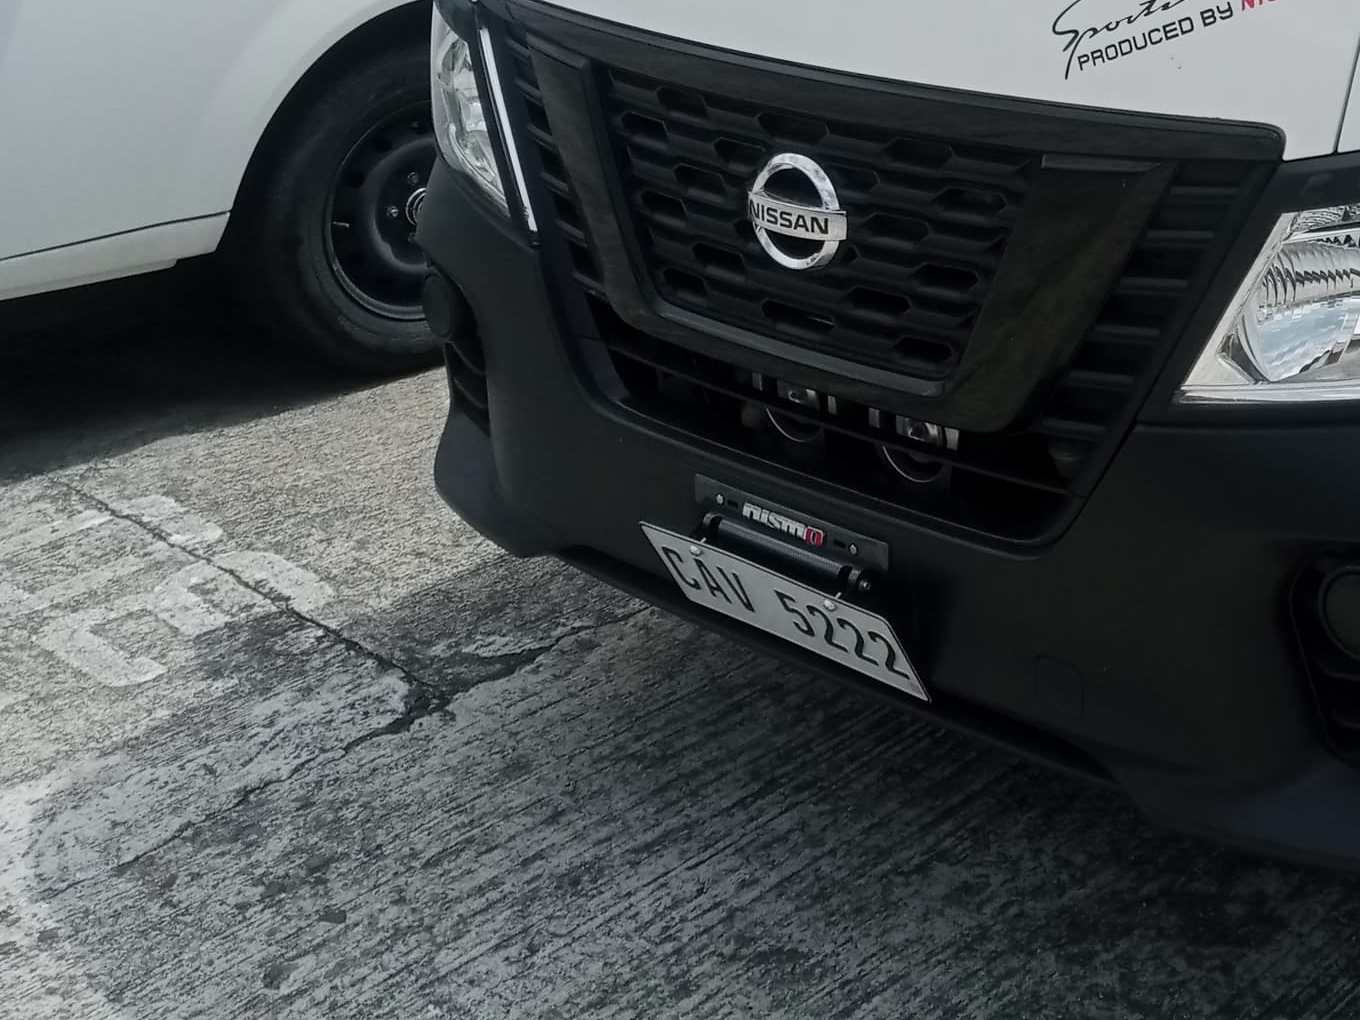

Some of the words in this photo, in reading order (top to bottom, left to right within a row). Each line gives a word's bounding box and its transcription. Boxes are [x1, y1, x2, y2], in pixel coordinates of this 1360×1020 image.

[1077, 16, 1195, 71] PRODUCED
[1200, 1, 1234, 28] BY
[749, 201, 830, 235] NISSAN
[661, 545, 755, 613] CAV
[774, 588, 910, 681] 5222
